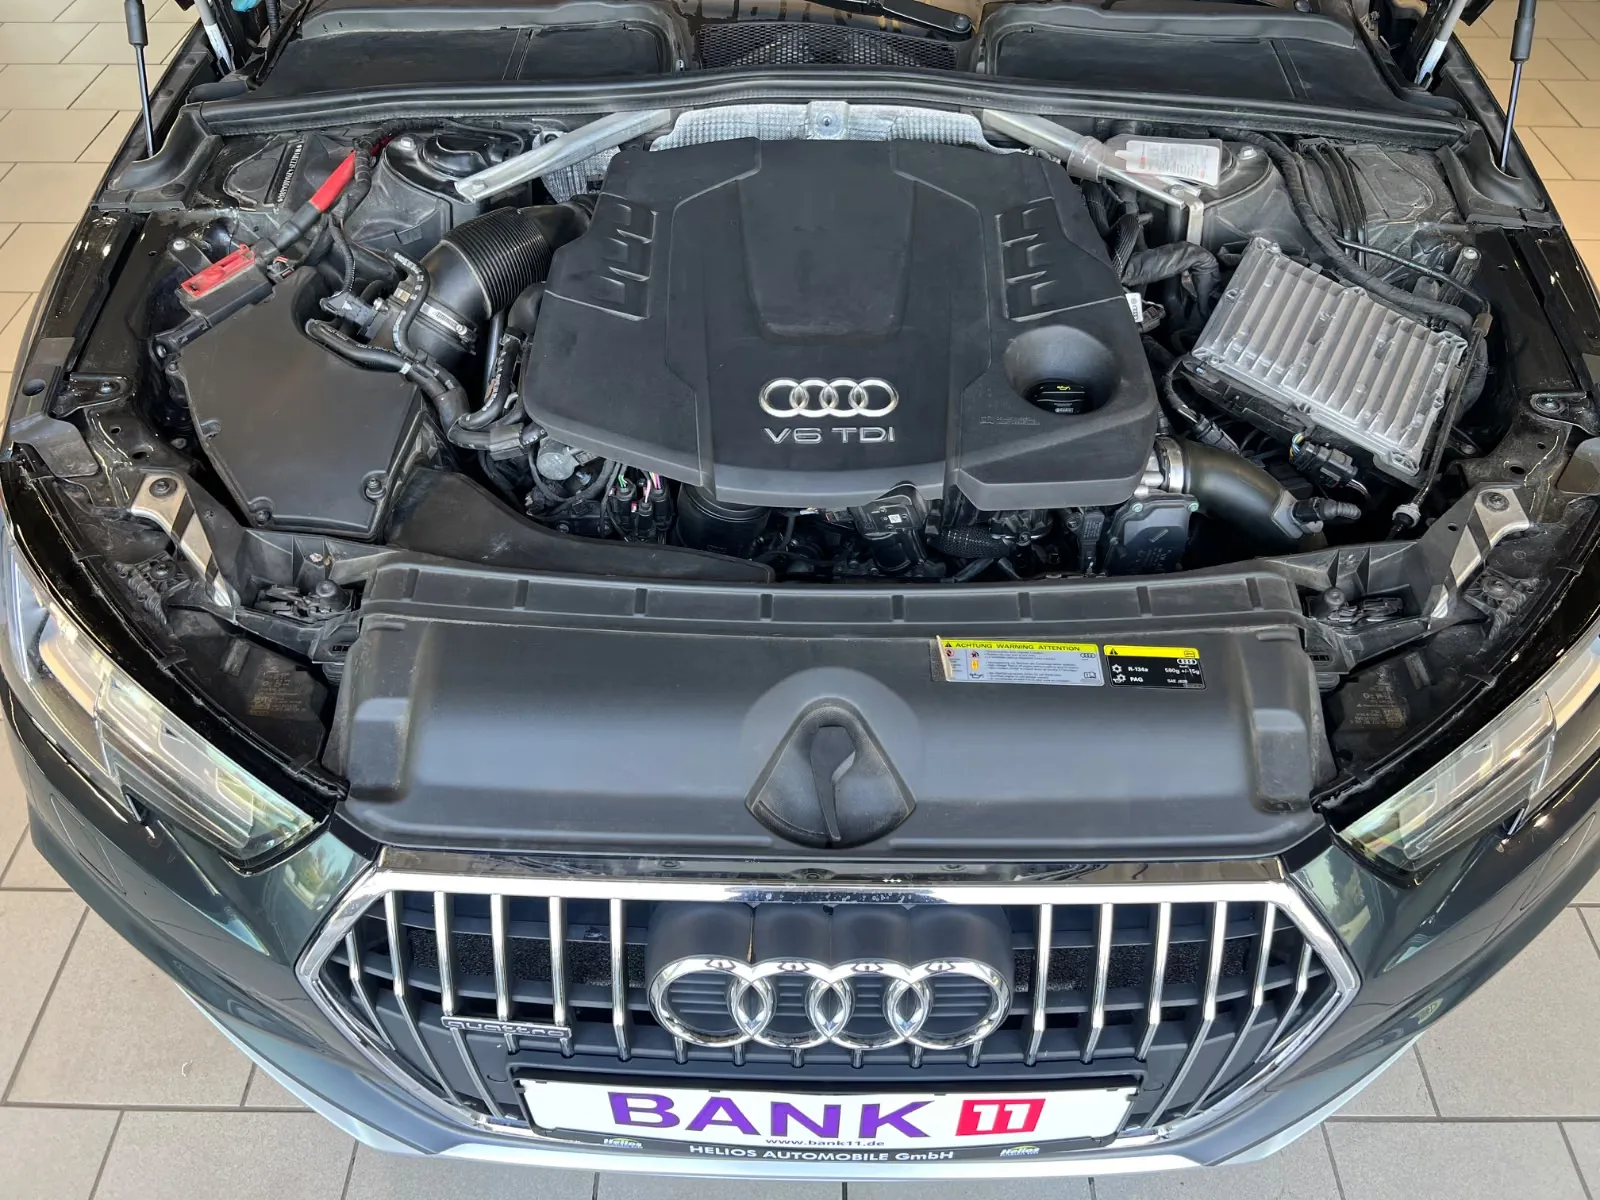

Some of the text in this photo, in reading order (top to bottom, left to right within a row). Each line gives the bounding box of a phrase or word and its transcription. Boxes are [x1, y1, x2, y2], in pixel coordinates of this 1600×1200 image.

[763, 426, 896, 444] V6 TDI
[447, 1021, 565, 1036] quattro
[607, 1092, 1031, 1138] BANK 11
[765, 1138, 885, 1147] www.bank11.de
[690, 1145, 954, 1161] HELIOS AUTOMOBILE GmbH
